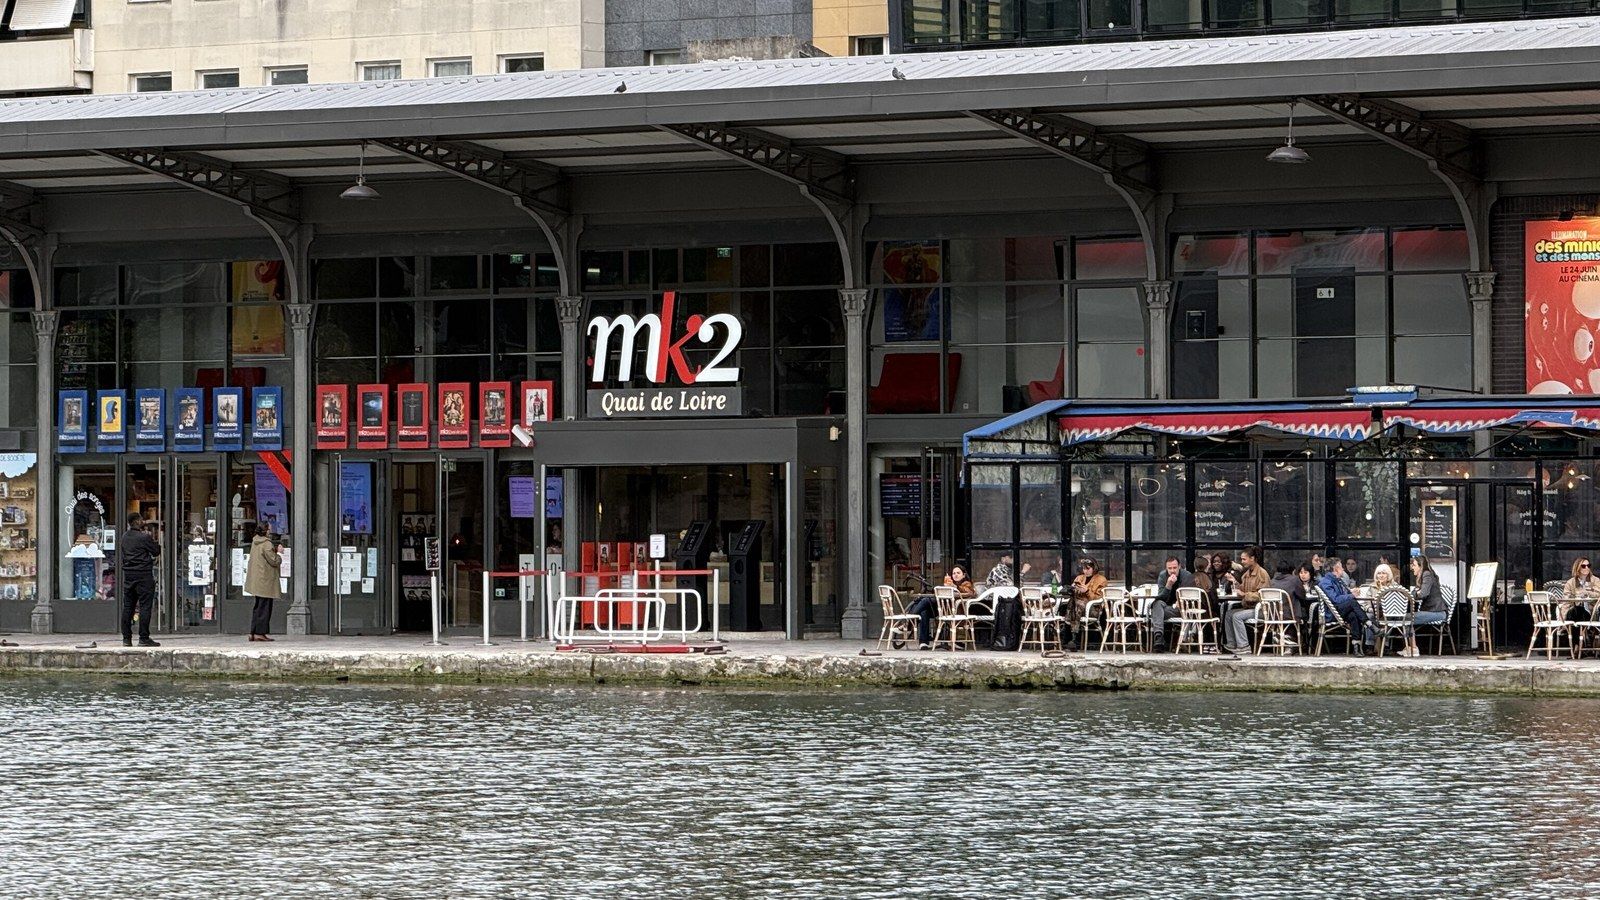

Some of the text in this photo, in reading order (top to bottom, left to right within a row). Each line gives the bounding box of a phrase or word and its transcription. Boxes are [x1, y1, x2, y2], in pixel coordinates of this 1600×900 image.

[1535, 240, 1563, 253] des
[1535, 253, 1548, 262] et
[1549, 253, 1570, 262] des
[1560, 265, 1598, 274] LE 24 JUIN
[1559, 273, 1600, 283] AU CINÉMA
[586, 291, 741, 384] mk2
[601, 391, 727, 416] Quai de Loire
